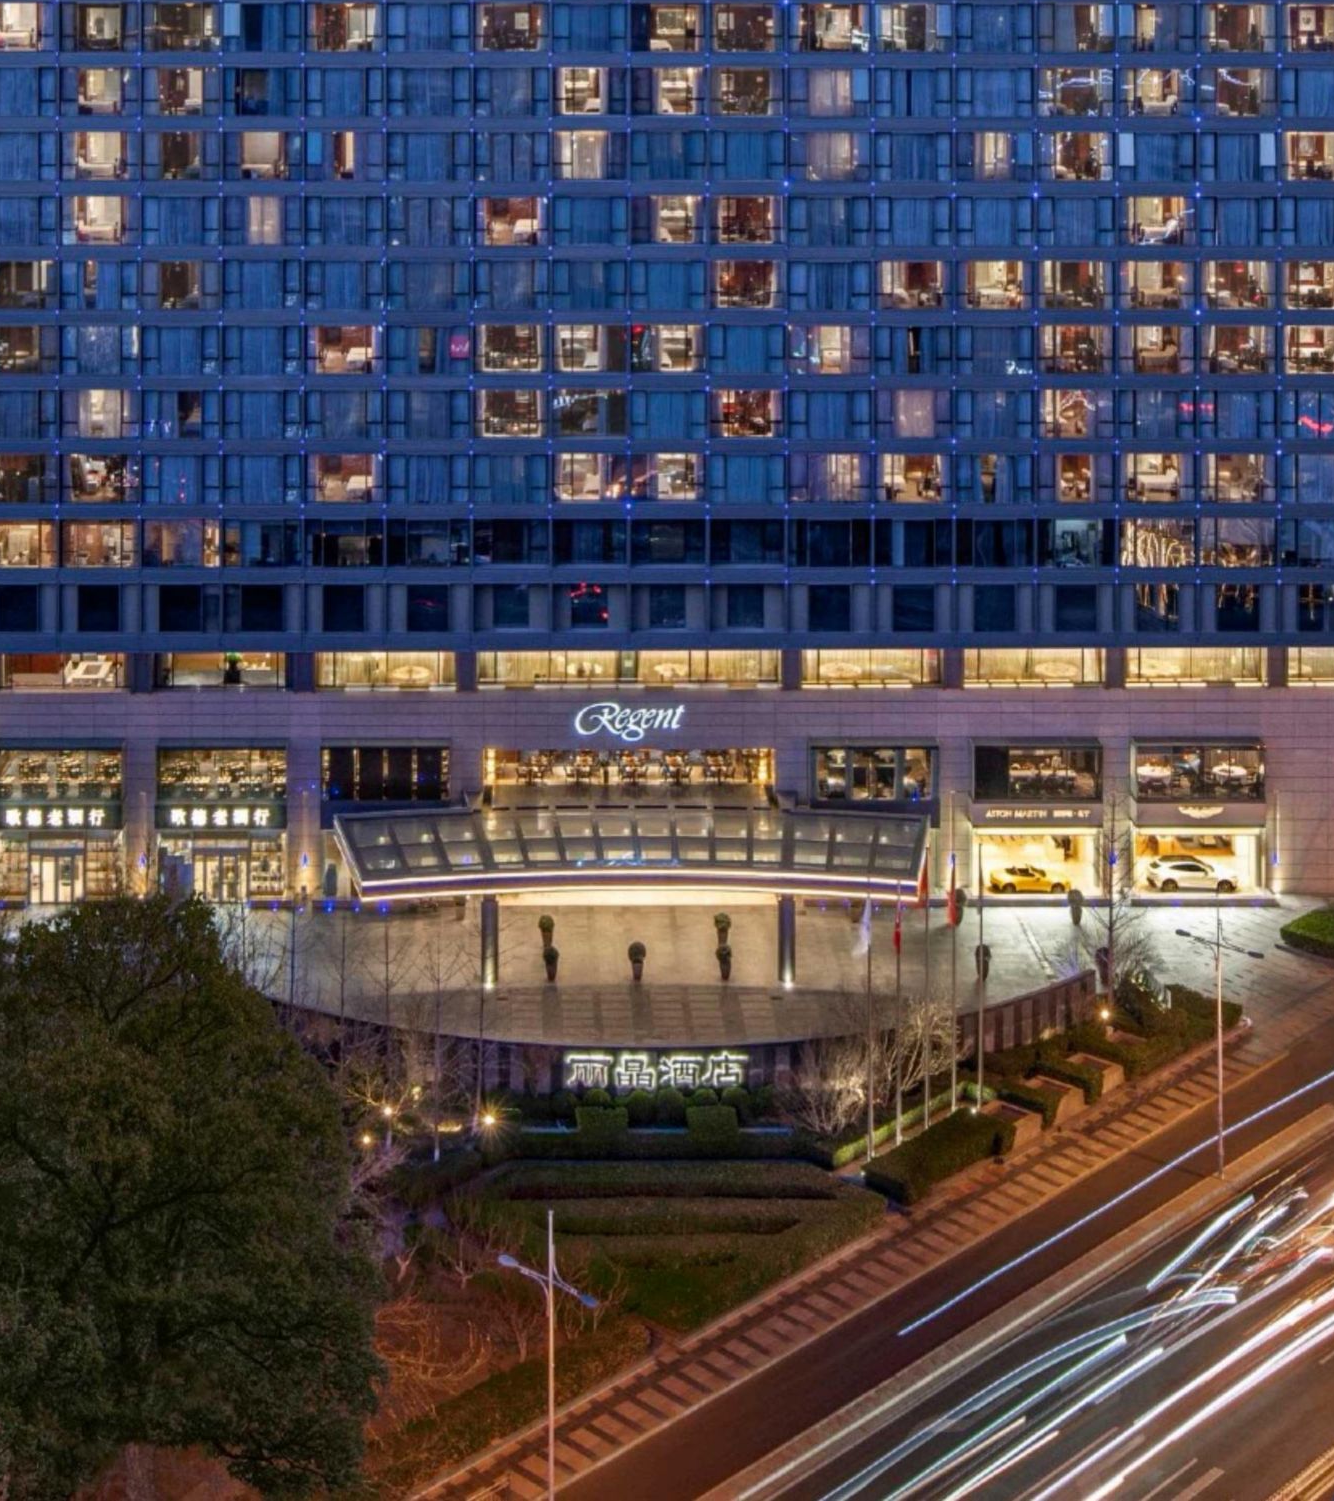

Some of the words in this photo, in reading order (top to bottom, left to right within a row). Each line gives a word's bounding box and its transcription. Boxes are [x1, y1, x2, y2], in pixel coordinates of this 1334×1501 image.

[574, 701, 685, 741] Regent
[564, 1052, 750, 1090] 丽晶酒店
